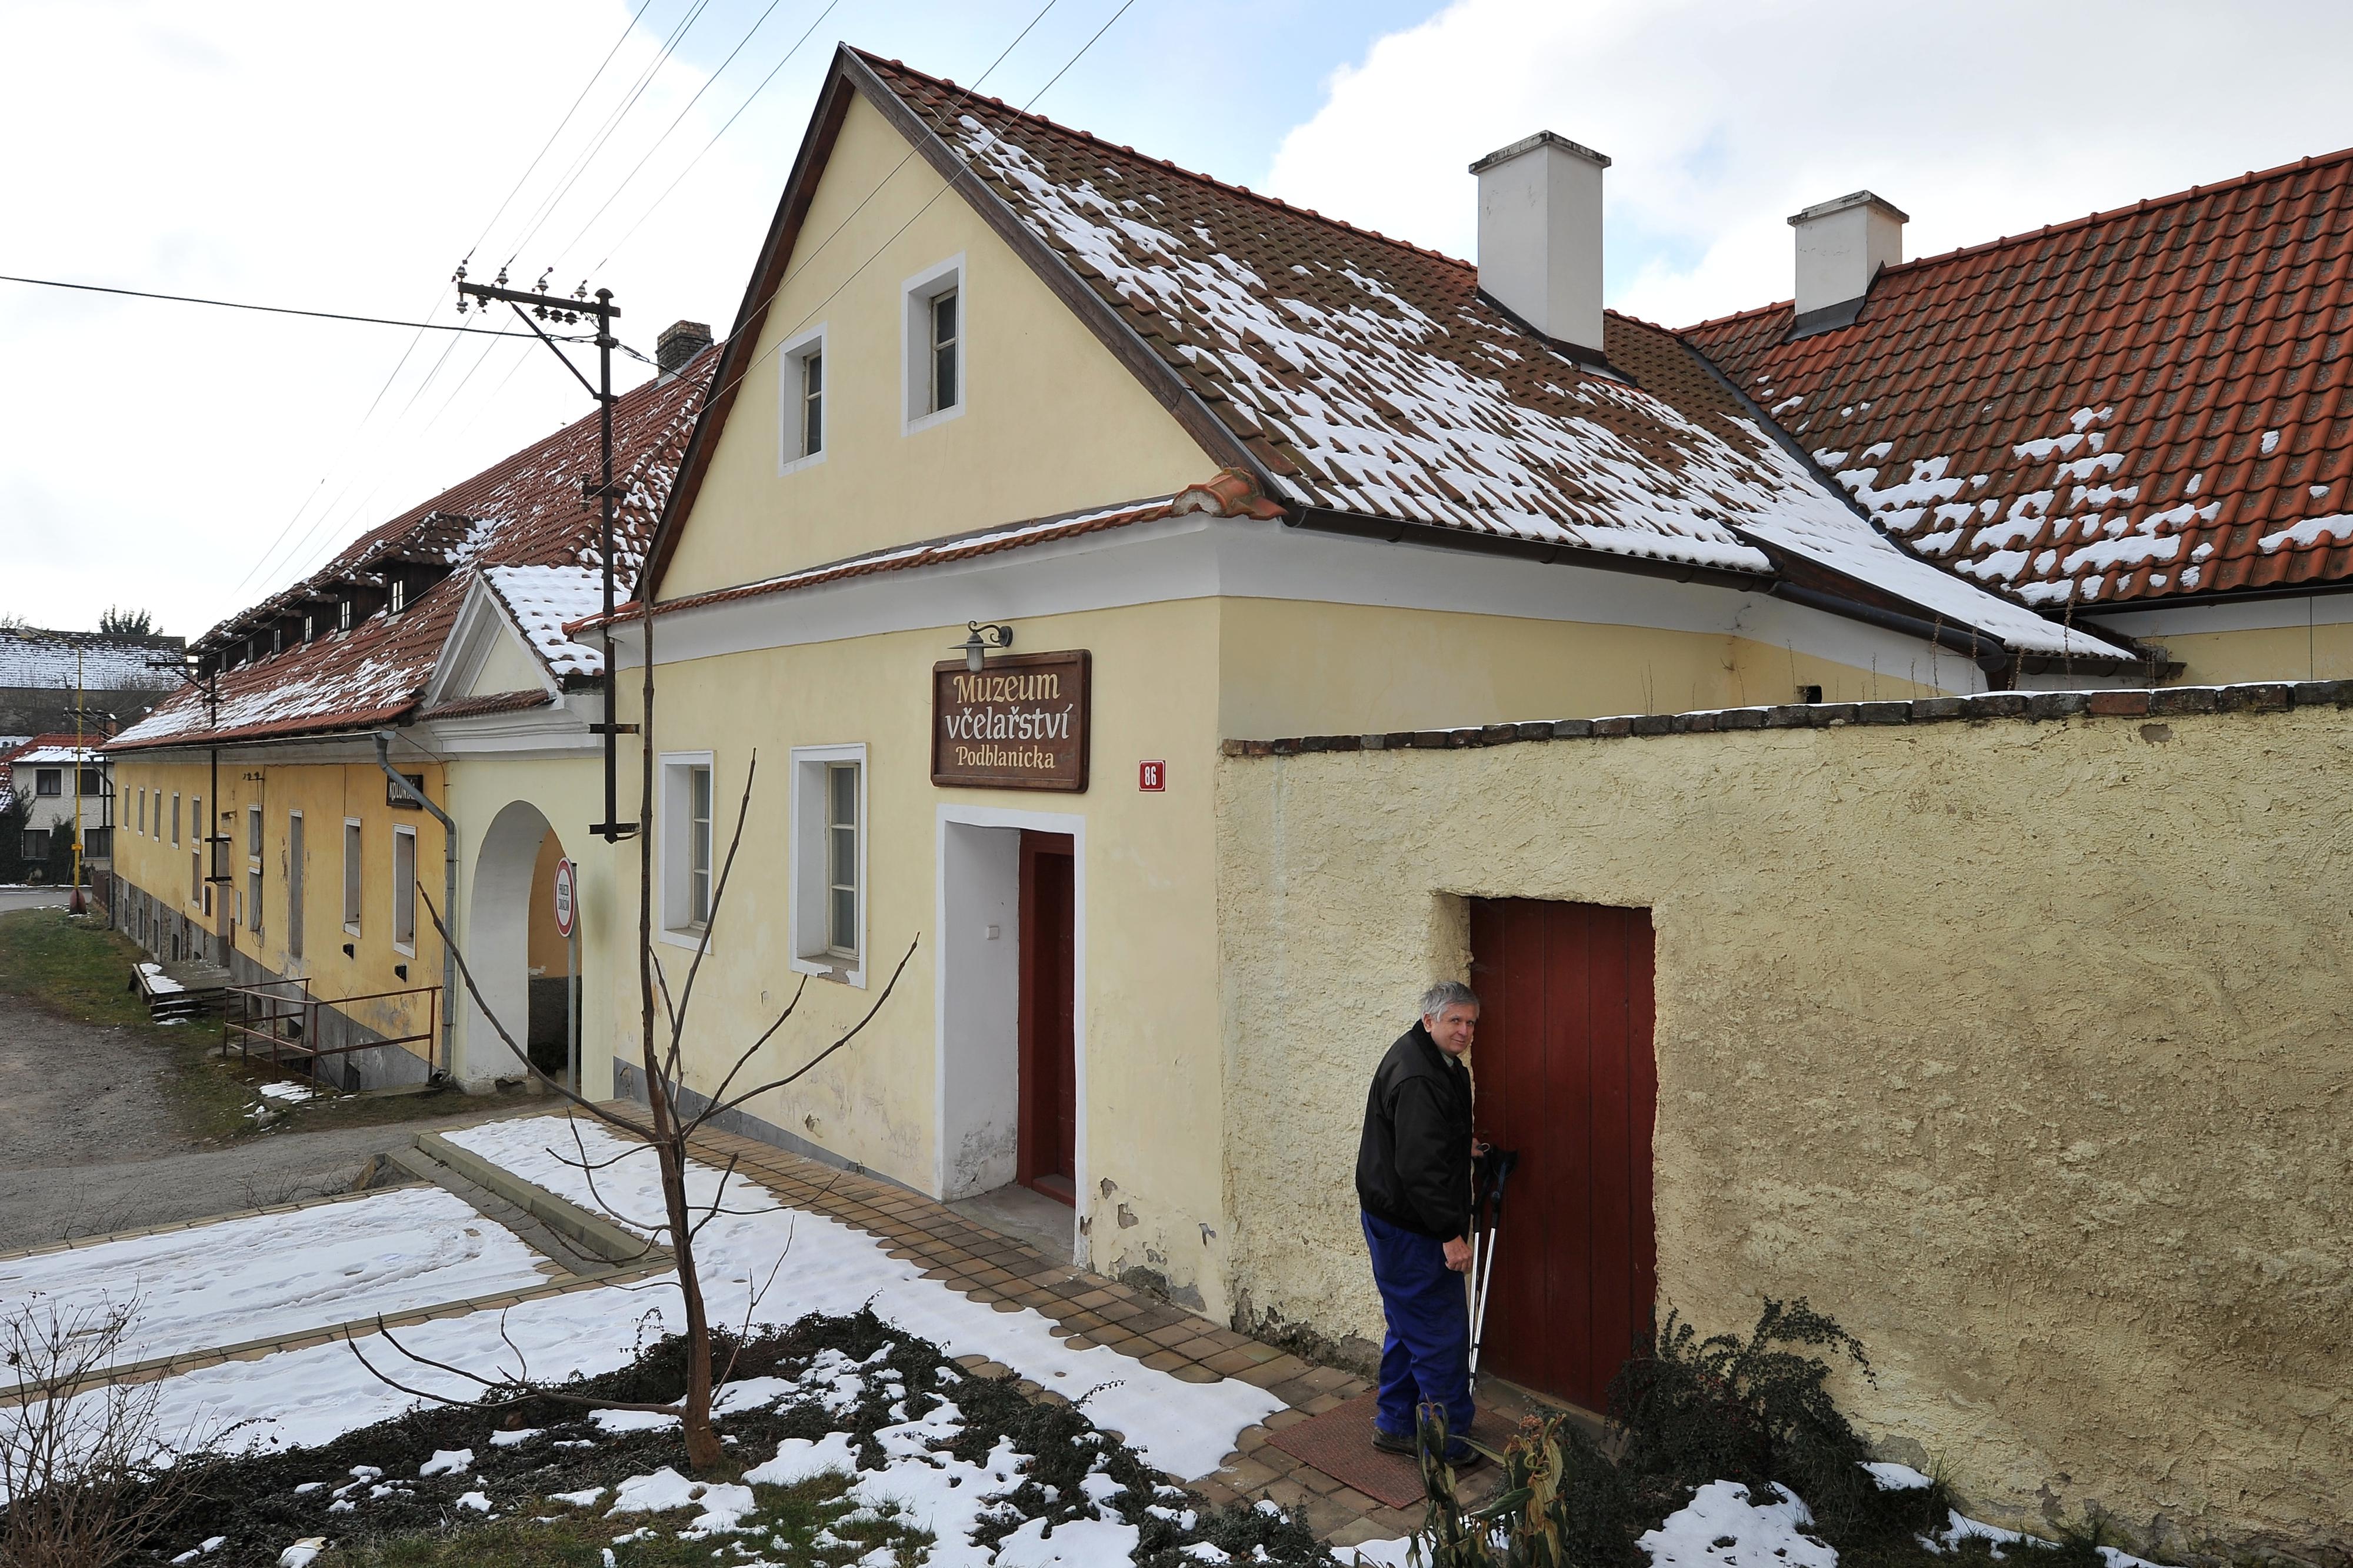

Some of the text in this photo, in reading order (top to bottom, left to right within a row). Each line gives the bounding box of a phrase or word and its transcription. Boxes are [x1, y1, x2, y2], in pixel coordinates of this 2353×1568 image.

[953, 673, 1061, 704] Muzeum
[945, 703, 1074, 740] včelařství
[955, 744, 1056, 769] Podblanicka
[1144, 766, 1156, 786] 86
